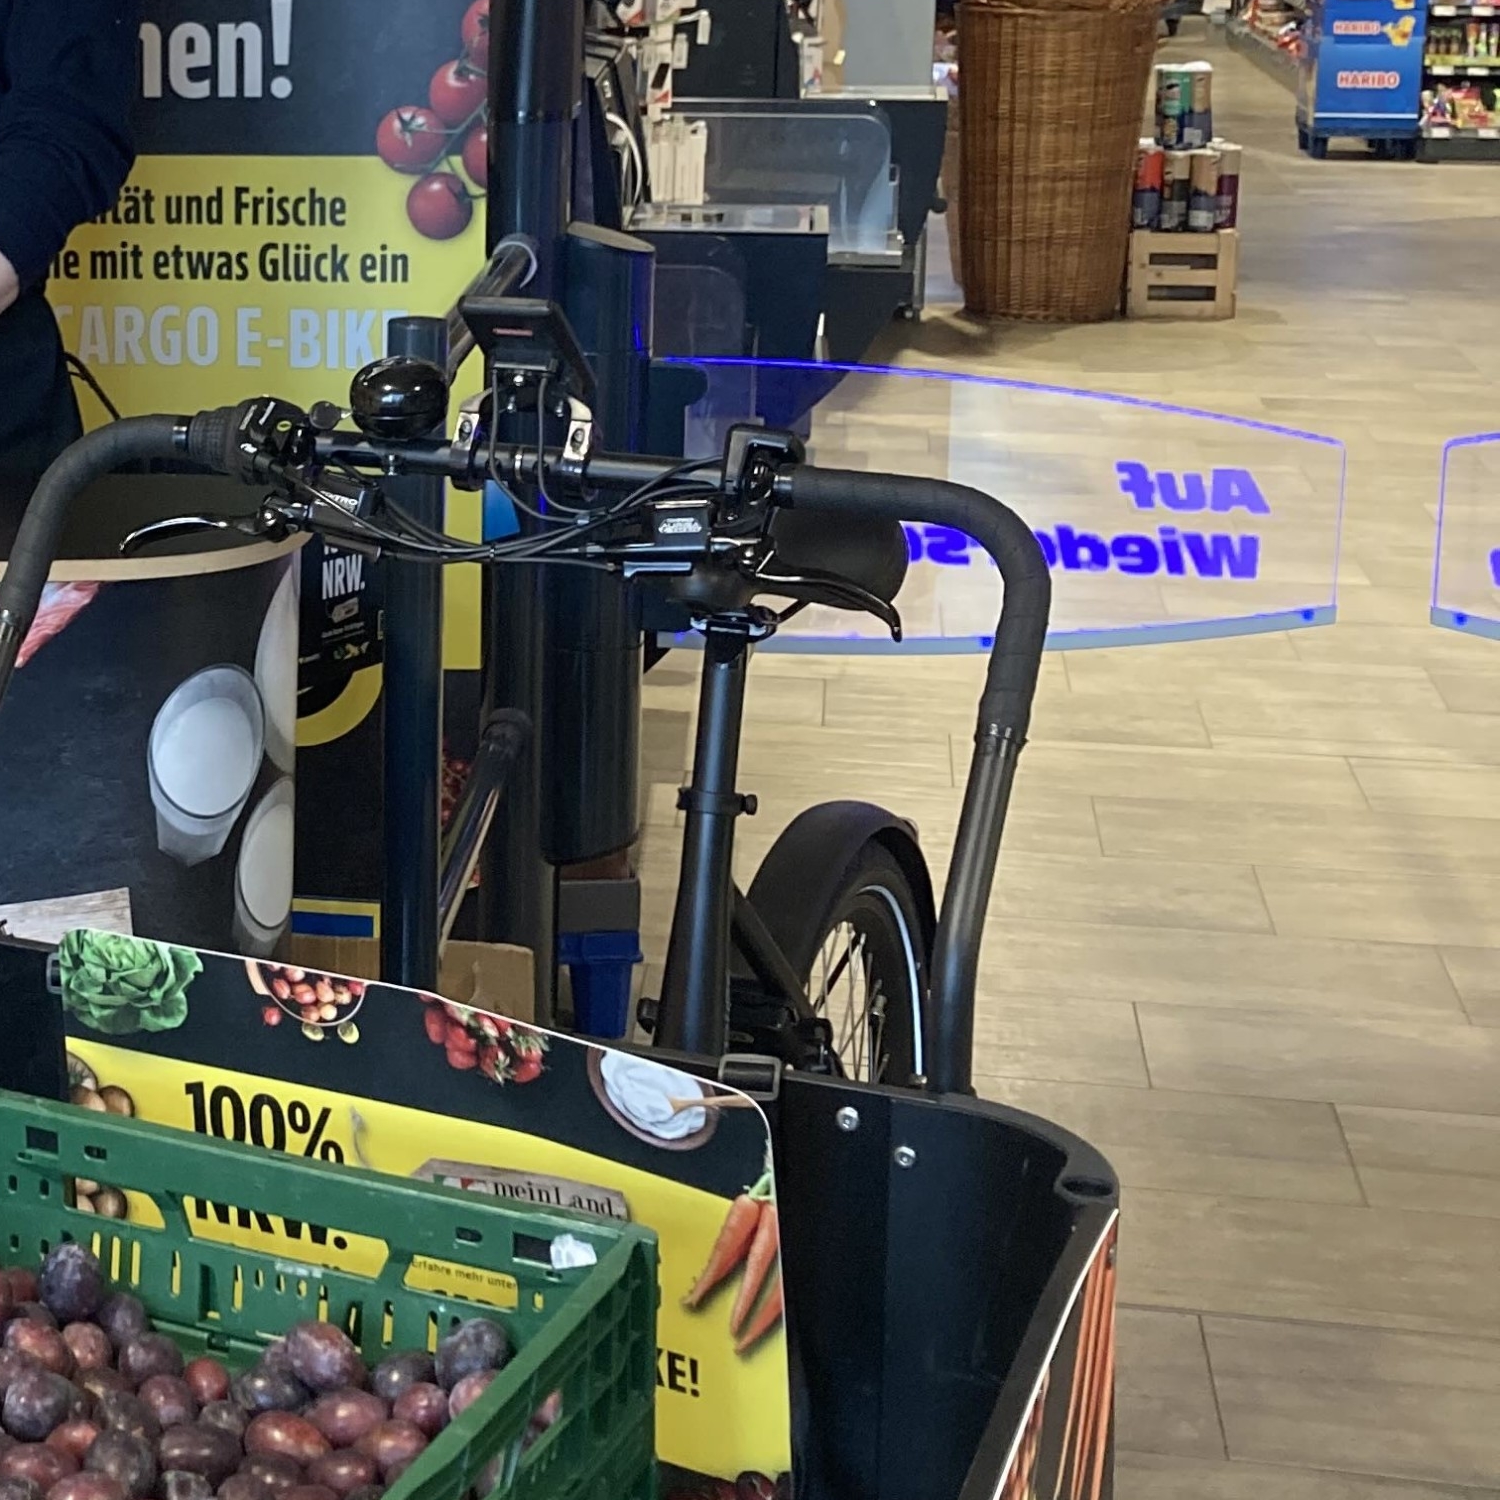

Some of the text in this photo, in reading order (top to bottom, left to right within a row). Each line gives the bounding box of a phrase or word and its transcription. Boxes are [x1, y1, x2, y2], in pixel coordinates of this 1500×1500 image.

[1333, 20, 1381, 35] HARIBO
[1337, 71, 1400, 89] HARIBO
[89, 186, 346, 226] tät und Frische
[90, 241, 143, 280] mit
[153, 245, 249, 281] etwas
[258, 242, 349, 283] Glück
[359, 244, 409, 283] ein
[322, 554, 365, 600] NRW.
[184, 1081, 344, 1164] 100%
[455, 1269, 483, 1282] mehr
